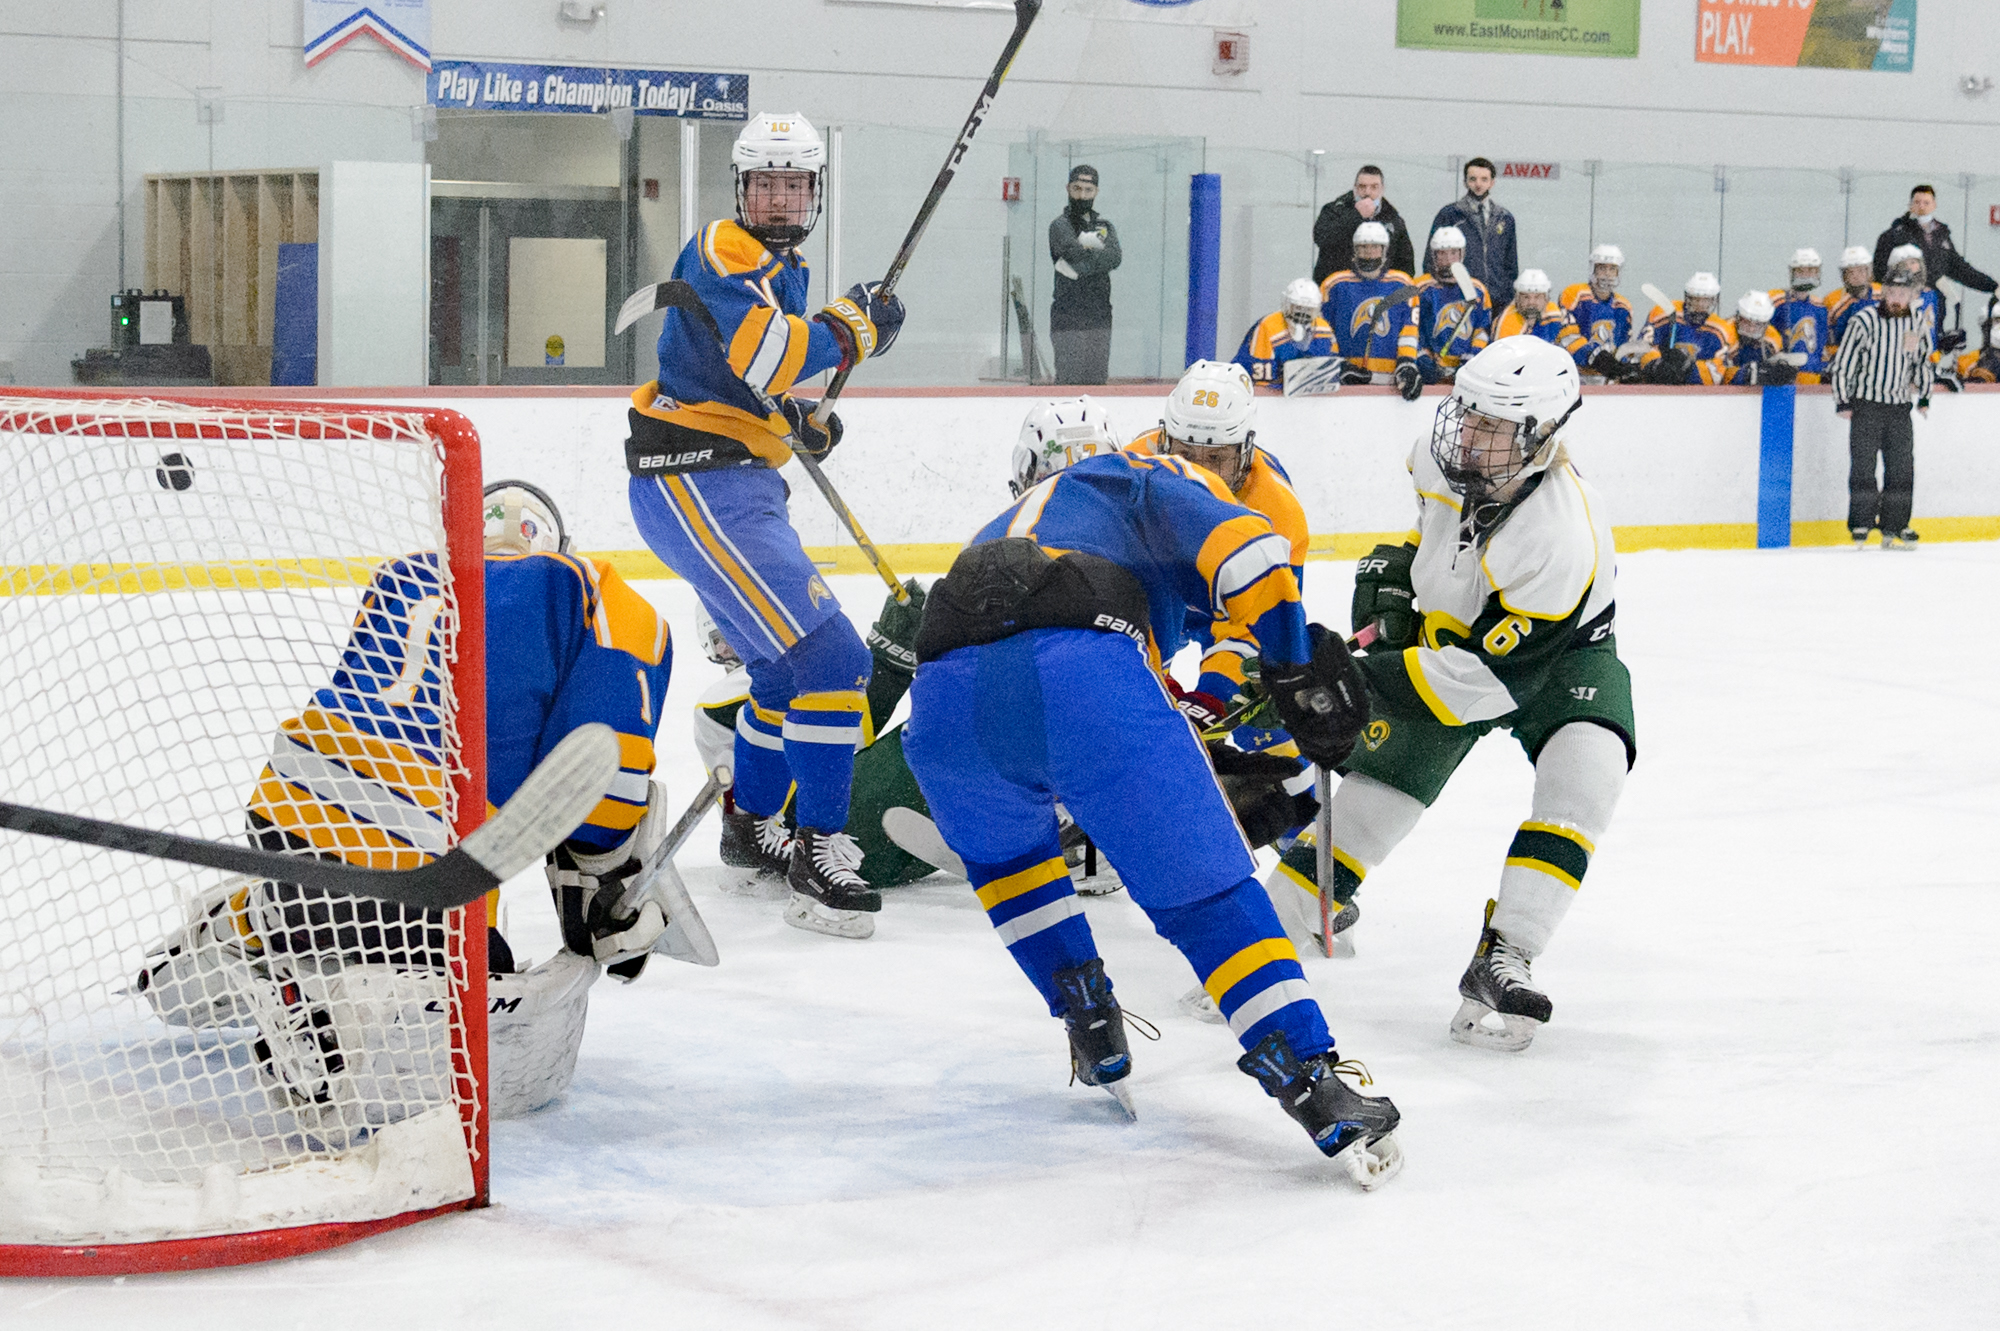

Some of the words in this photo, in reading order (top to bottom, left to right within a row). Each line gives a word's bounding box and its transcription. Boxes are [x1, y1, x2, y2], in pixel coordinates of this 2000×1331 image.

[1434, 22, 1611, 43] www.EastMountainCC.com
[1702, 11, 1755, 55] PLAY.
[438, 69, 480, 108] Play
[483, 71, 523, 104] Like
[526, 80, 539, 104] a
[543, 74, 633, 112] Champion
[638, 78, 698, 116] Today!
[702, 98, 745, 112] Oasis
[771, 122, 790, 133] 10
[945, 92, 994, 171] CCM
[1503, 163, 1552, 178] AWAY
[1252, 362, 1273, 381] 31
[1192, 389, 1219, 408] 26
[639, 449, 714, 469] BAUER
[1064, 443, 1097, 468] 17
[1482, 614, 1533, 656] 6
[636, 668, 653, 726] 1
